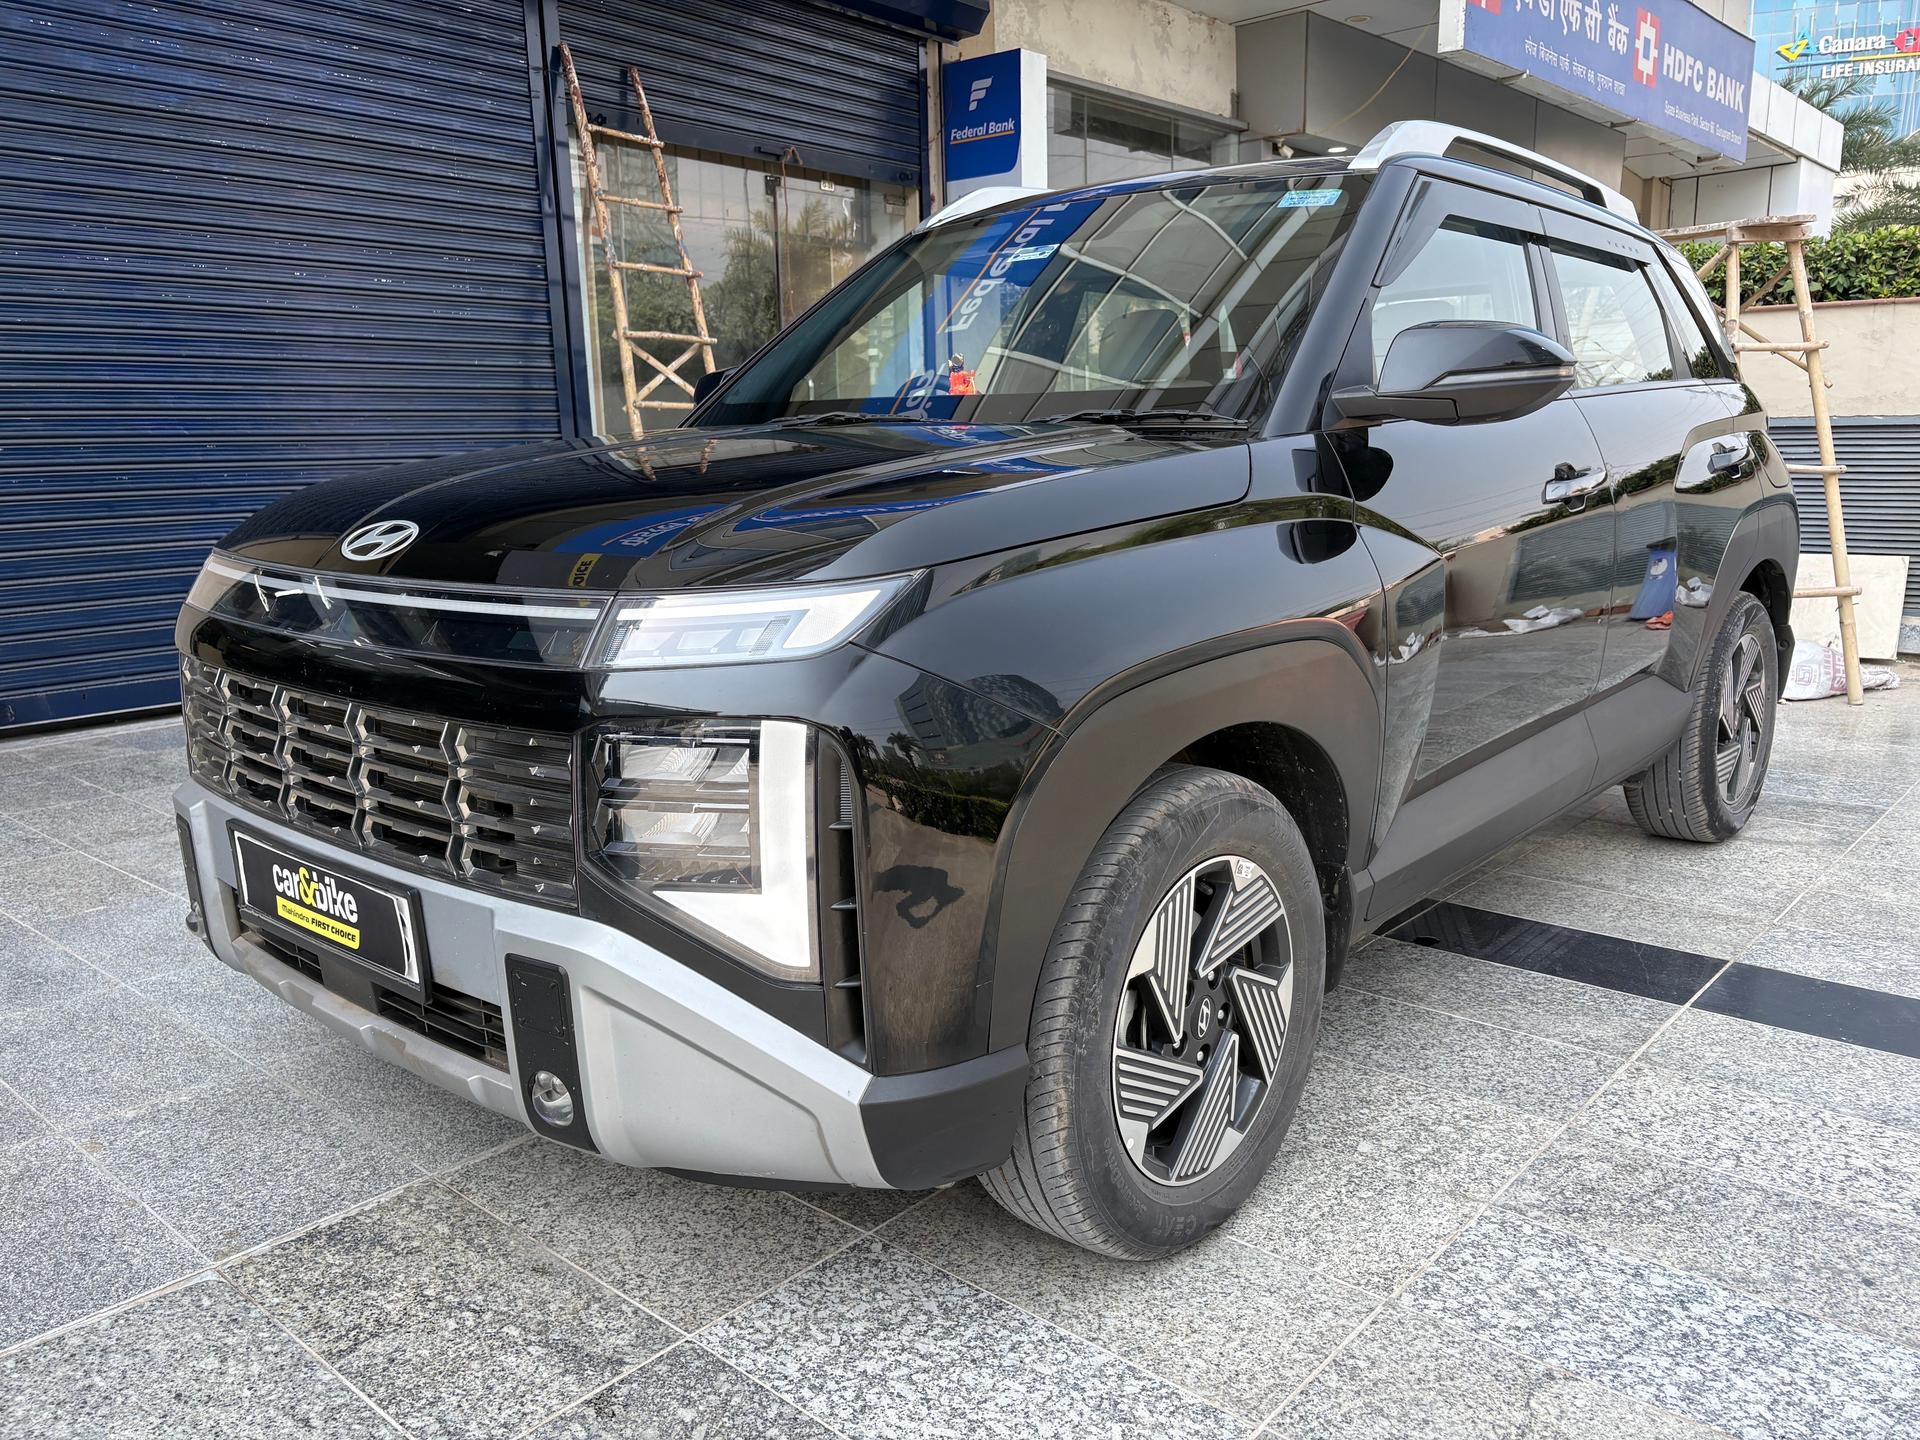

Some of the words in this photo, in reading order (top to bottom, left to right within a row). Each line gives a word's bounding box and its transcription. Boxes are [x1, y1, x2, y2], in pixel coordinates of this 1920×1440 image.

[1608, 3, 1630, 56] बैंक
[1818, 34, 1887, 55] Canara
[1662, 43, 1704, 93] HDFC
[1706, 65, 1745, 113] BANK
[1821, 62, 1854, 80] LIFE
[950, 122, 987, 141] Federal
[988, 117, 1015, 134] Bank
[272, 863, 359, 924] car&bike
[281, 904, 310, 923] Mahindra
[310, 917, 330, 932] FIRST
[330, 925, 357, 943] CHOICE
